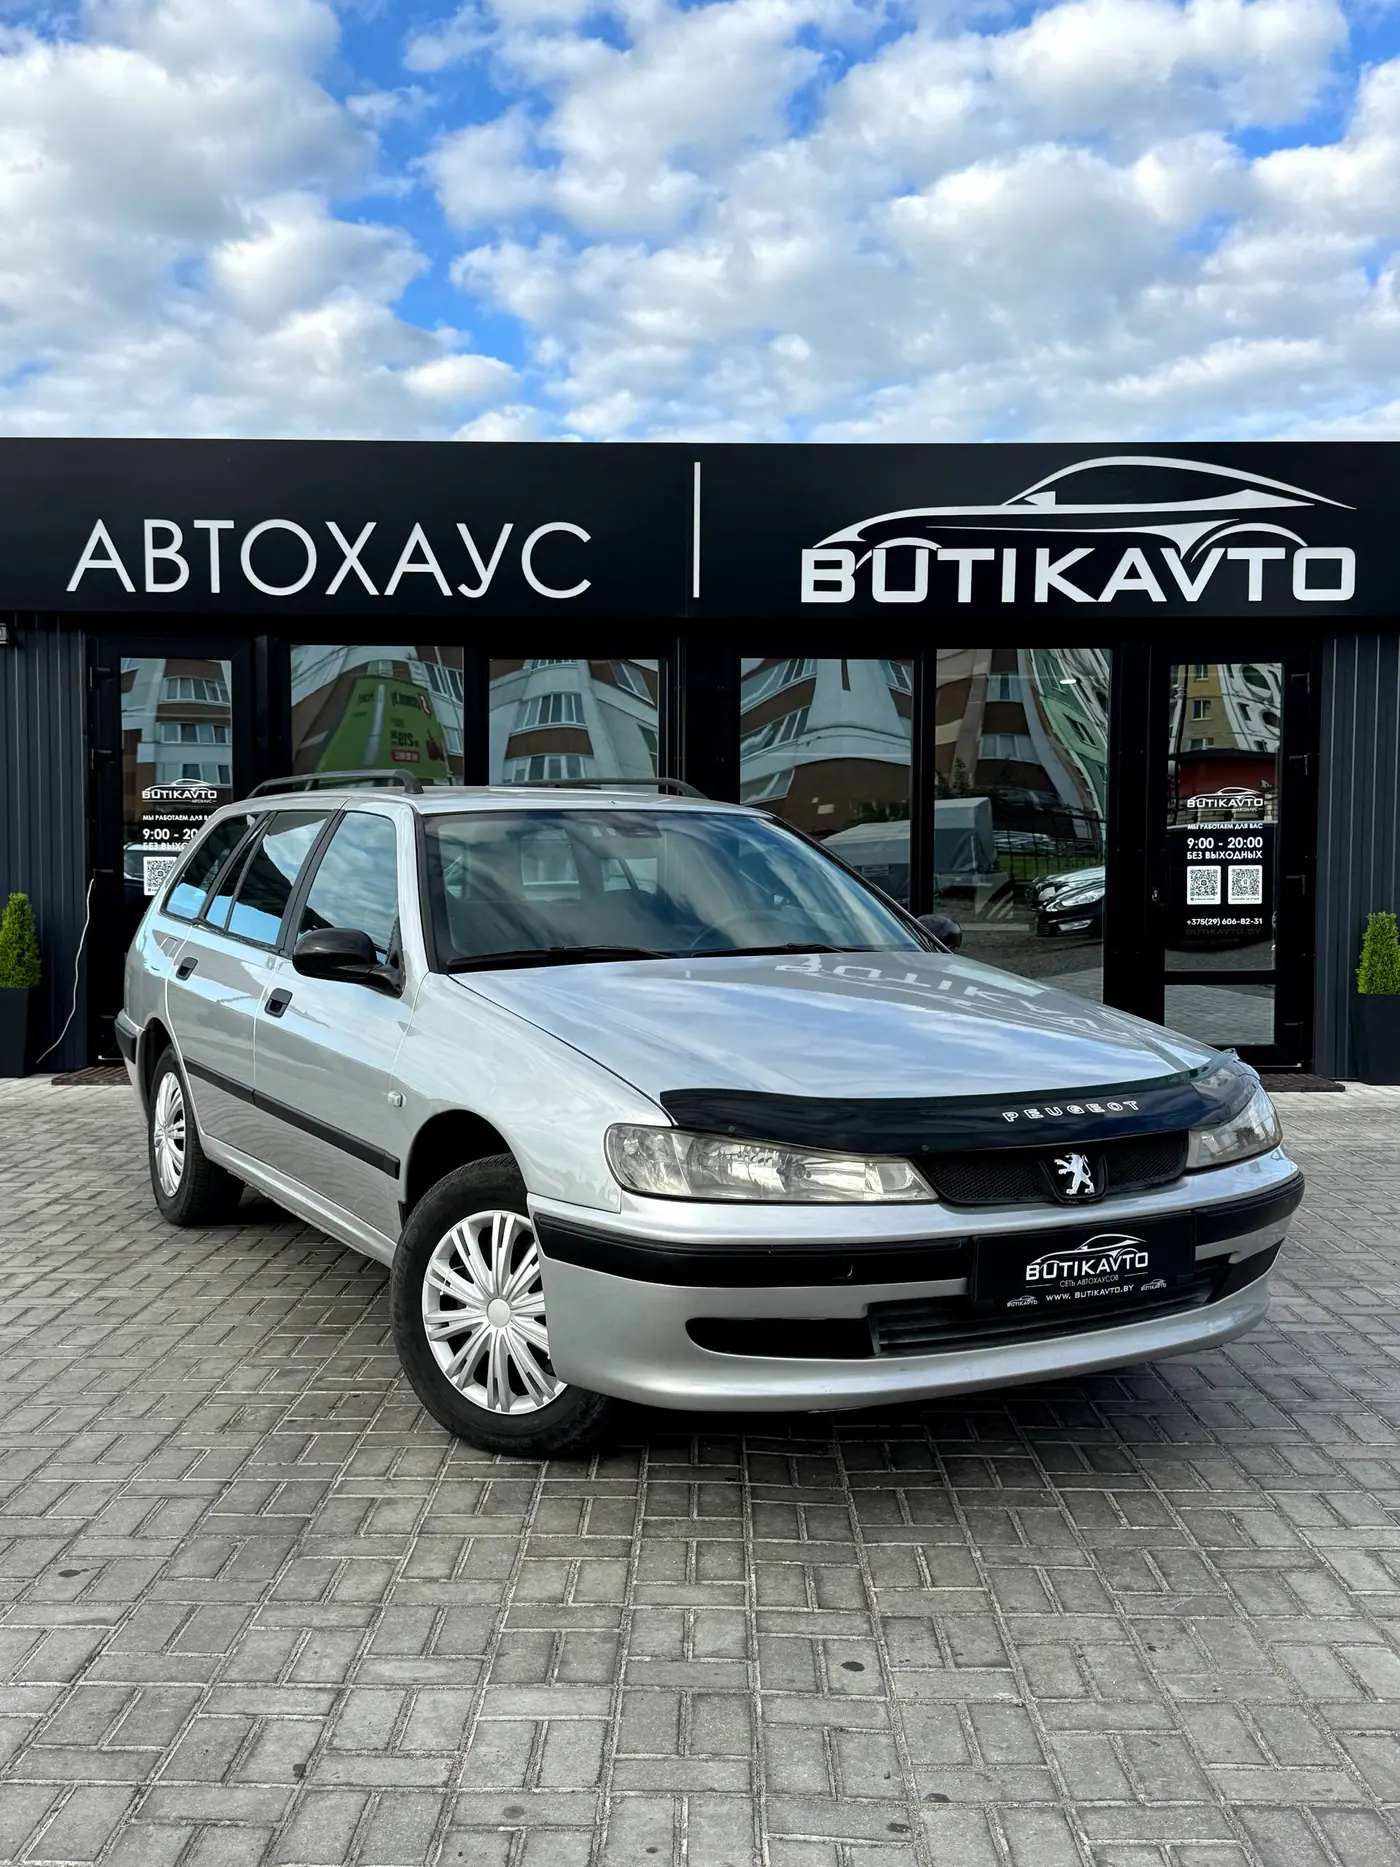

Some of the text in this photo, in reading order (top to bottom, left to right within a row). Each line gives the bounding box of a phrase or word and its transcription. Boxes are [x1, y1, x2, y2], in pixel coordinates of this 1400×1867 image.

[66, 518, 592, 598] АВТОХАУС
[801, 546, 1356, 603] BUTIKAVTO
[142, 790, 217, 799] BUTIKAVTO
[1187, 798, 1263, 808] BUTIKAVTO
[142, 828, 170, 840] 9:00
[142, 842, 160, 850] БЕЗ
[1187, 837, 1215, 849] 9:00
[1227, 836, 1263, 849] 20:00
[1187, 850, 1263, 860] БЕЗ ВЫХОДНЫХ
[1186, 918, 1220, 926] +375(29)
[1002, 1101, 1139, 1123] PEUGEOT
[1025, 1252, 1149, 1281] BUTIKAVTO
[1059, 1274, 1119, 1288] СЕТЬ АВТОХАУСОВ
[1045, 1284, 1134, 1302] WWW. BUTIKAVTO.BY
[1006, 1300, 1038, 1308] BUTIKAVTO
